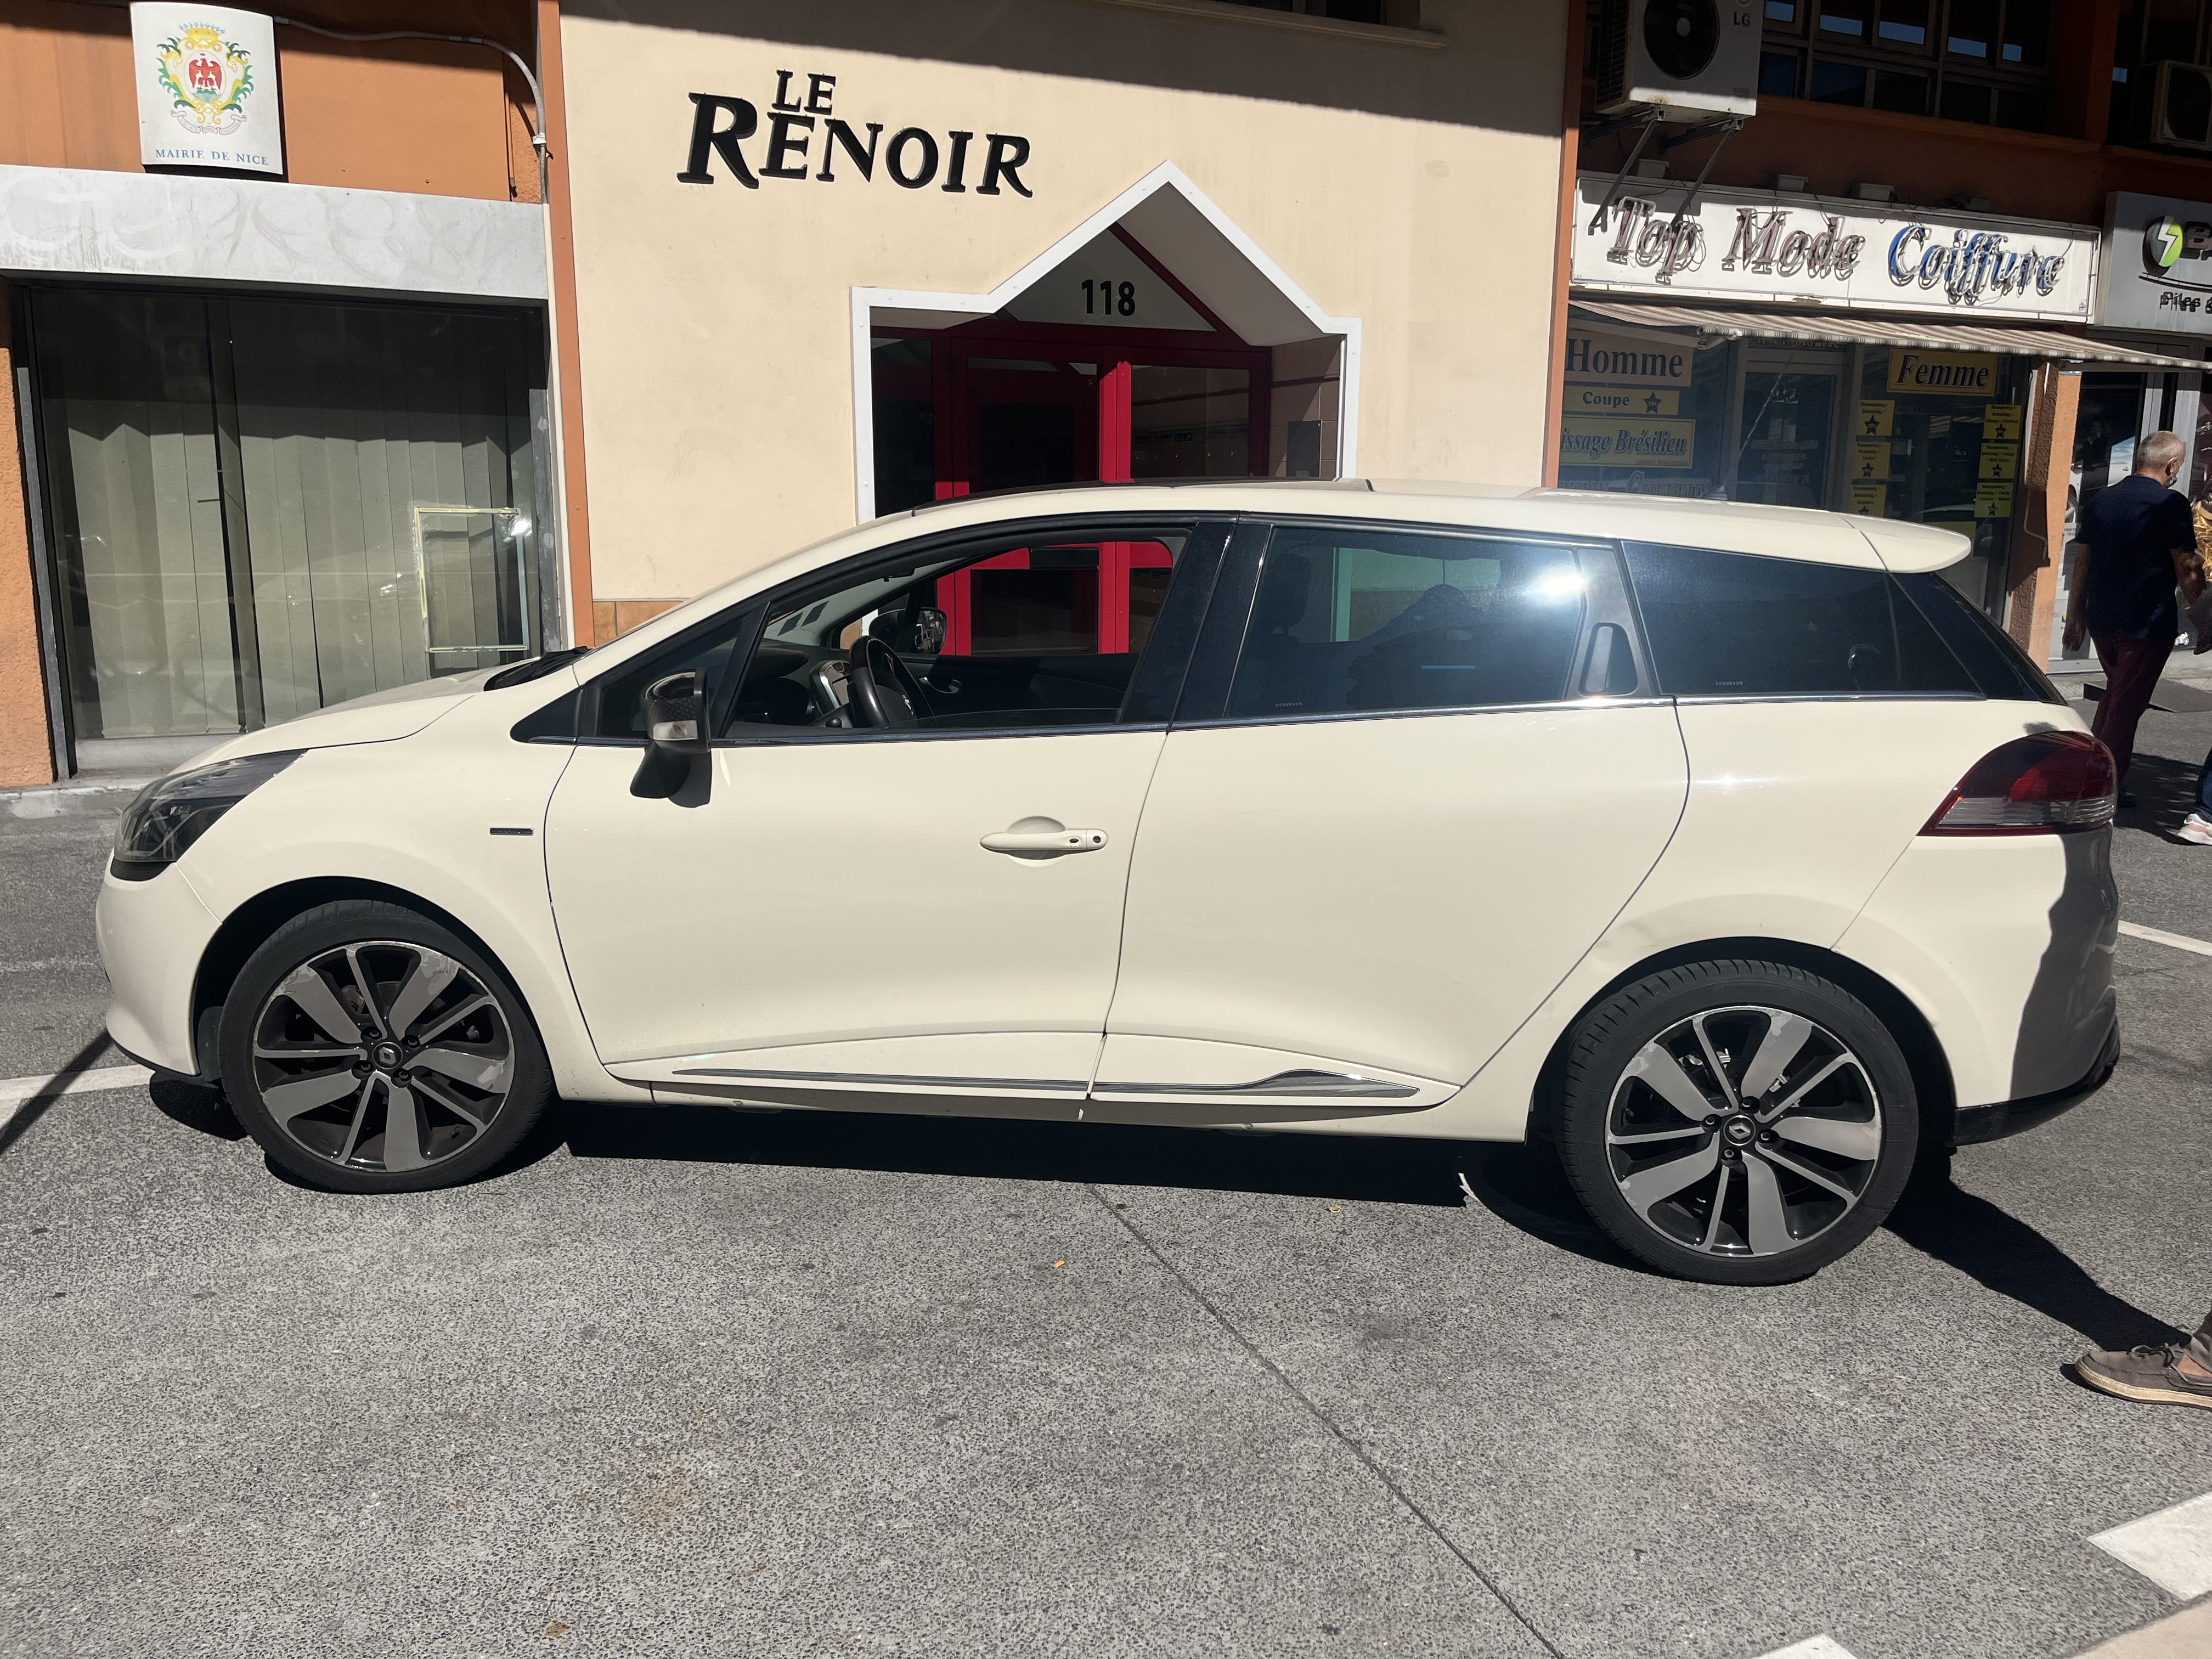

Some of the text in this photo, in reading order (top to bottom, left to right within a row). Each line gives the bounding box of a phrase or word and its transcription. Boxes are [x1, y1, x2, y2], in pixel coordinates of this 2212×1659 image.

[1733, 11, 1751, 27] LG
[771, 69, 837, 115] LE
[155, 149, 269, 165] MAIRIE DE NICE
[676, 91, 1034, 198] RENOIR
[1609, 196, 2065, 300] Top Mode Coiffure
[2185, 221, 2212, 251] B
[1081, 279, 1136, 317] 118
[2162, 291, 2201, 308] Piles
[1566, 338, 1683, 378] Homme
[1896, 354, 1989, 388] Femme
[1582, 391, 1630, 409] Coupe
[1561, 427, 1686, 456] issage Brésilien
